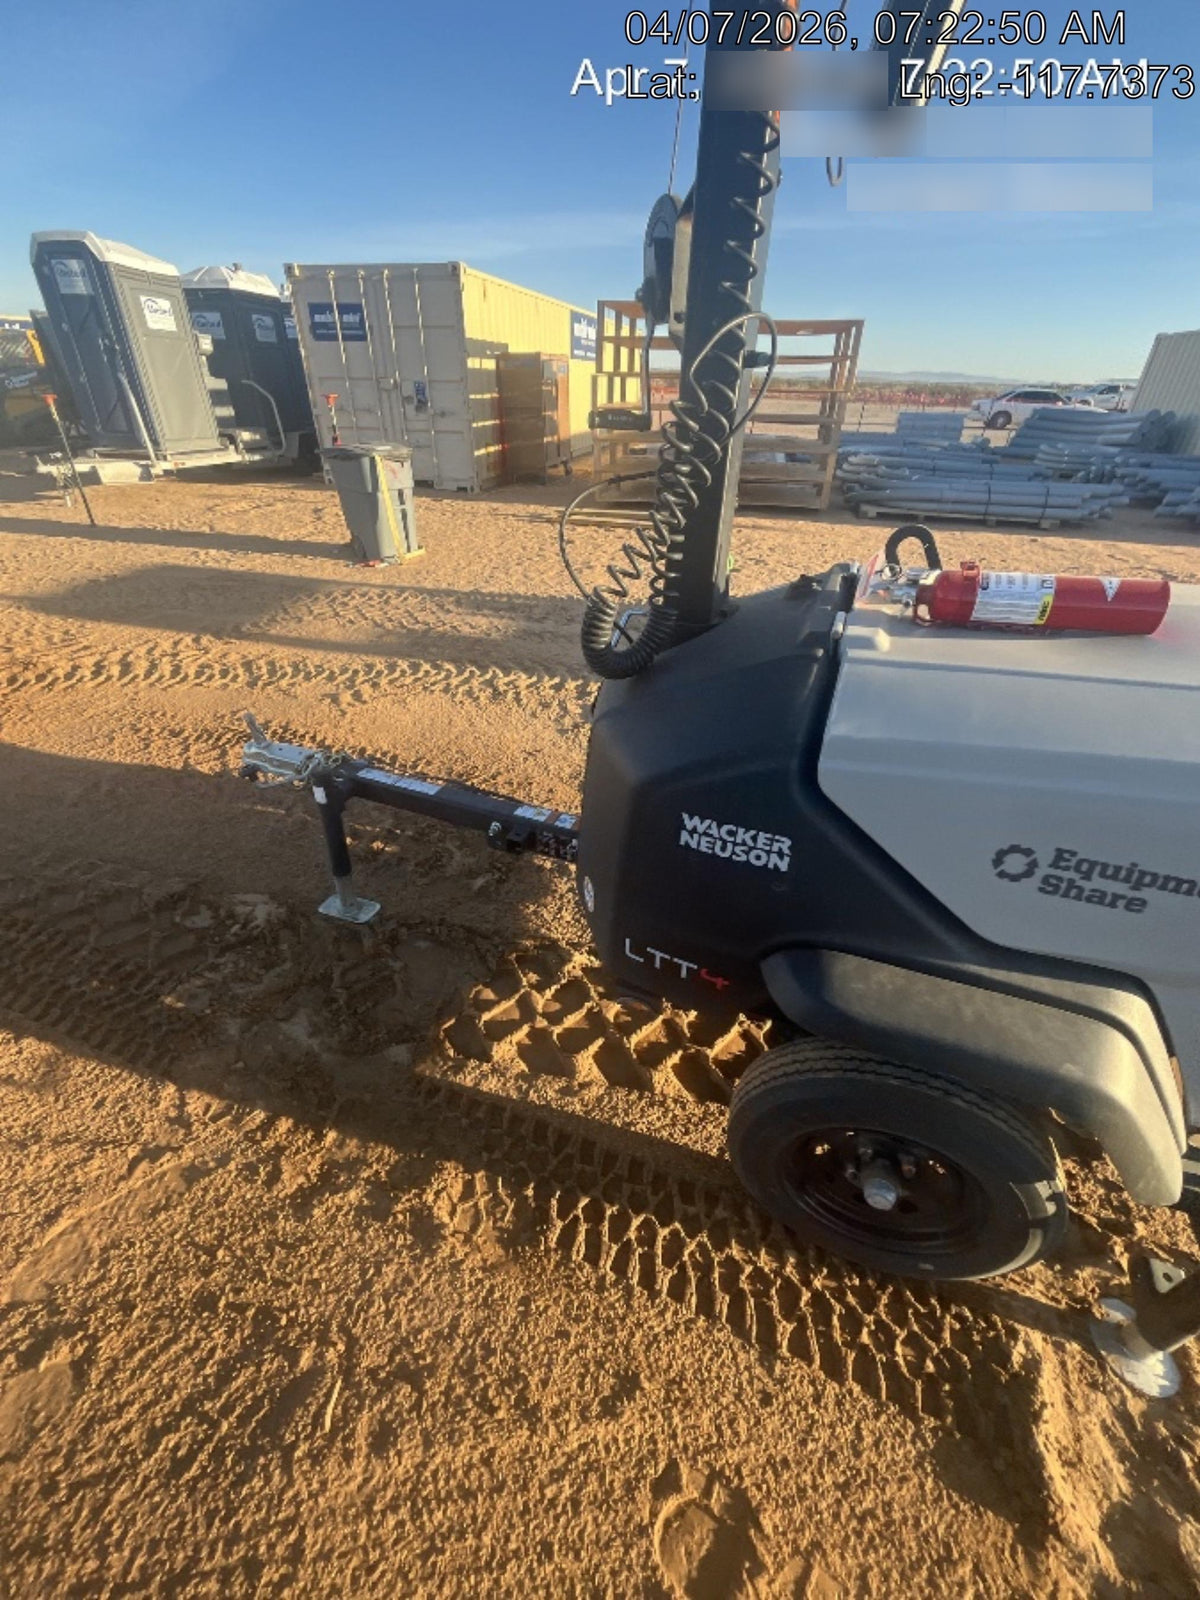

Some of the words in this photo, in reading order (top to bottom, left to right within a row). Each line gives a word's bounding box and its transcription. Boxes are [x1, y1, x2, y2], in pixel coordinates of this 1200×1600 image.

[679, 829, 792, 872] NEUSON
[681, 812, 792, 855] WACKER
[1037, 873, 1148, 914] Share
[1047, 847, 1200, 898] Equipm
[625, 938, 730, 989] LTT4
